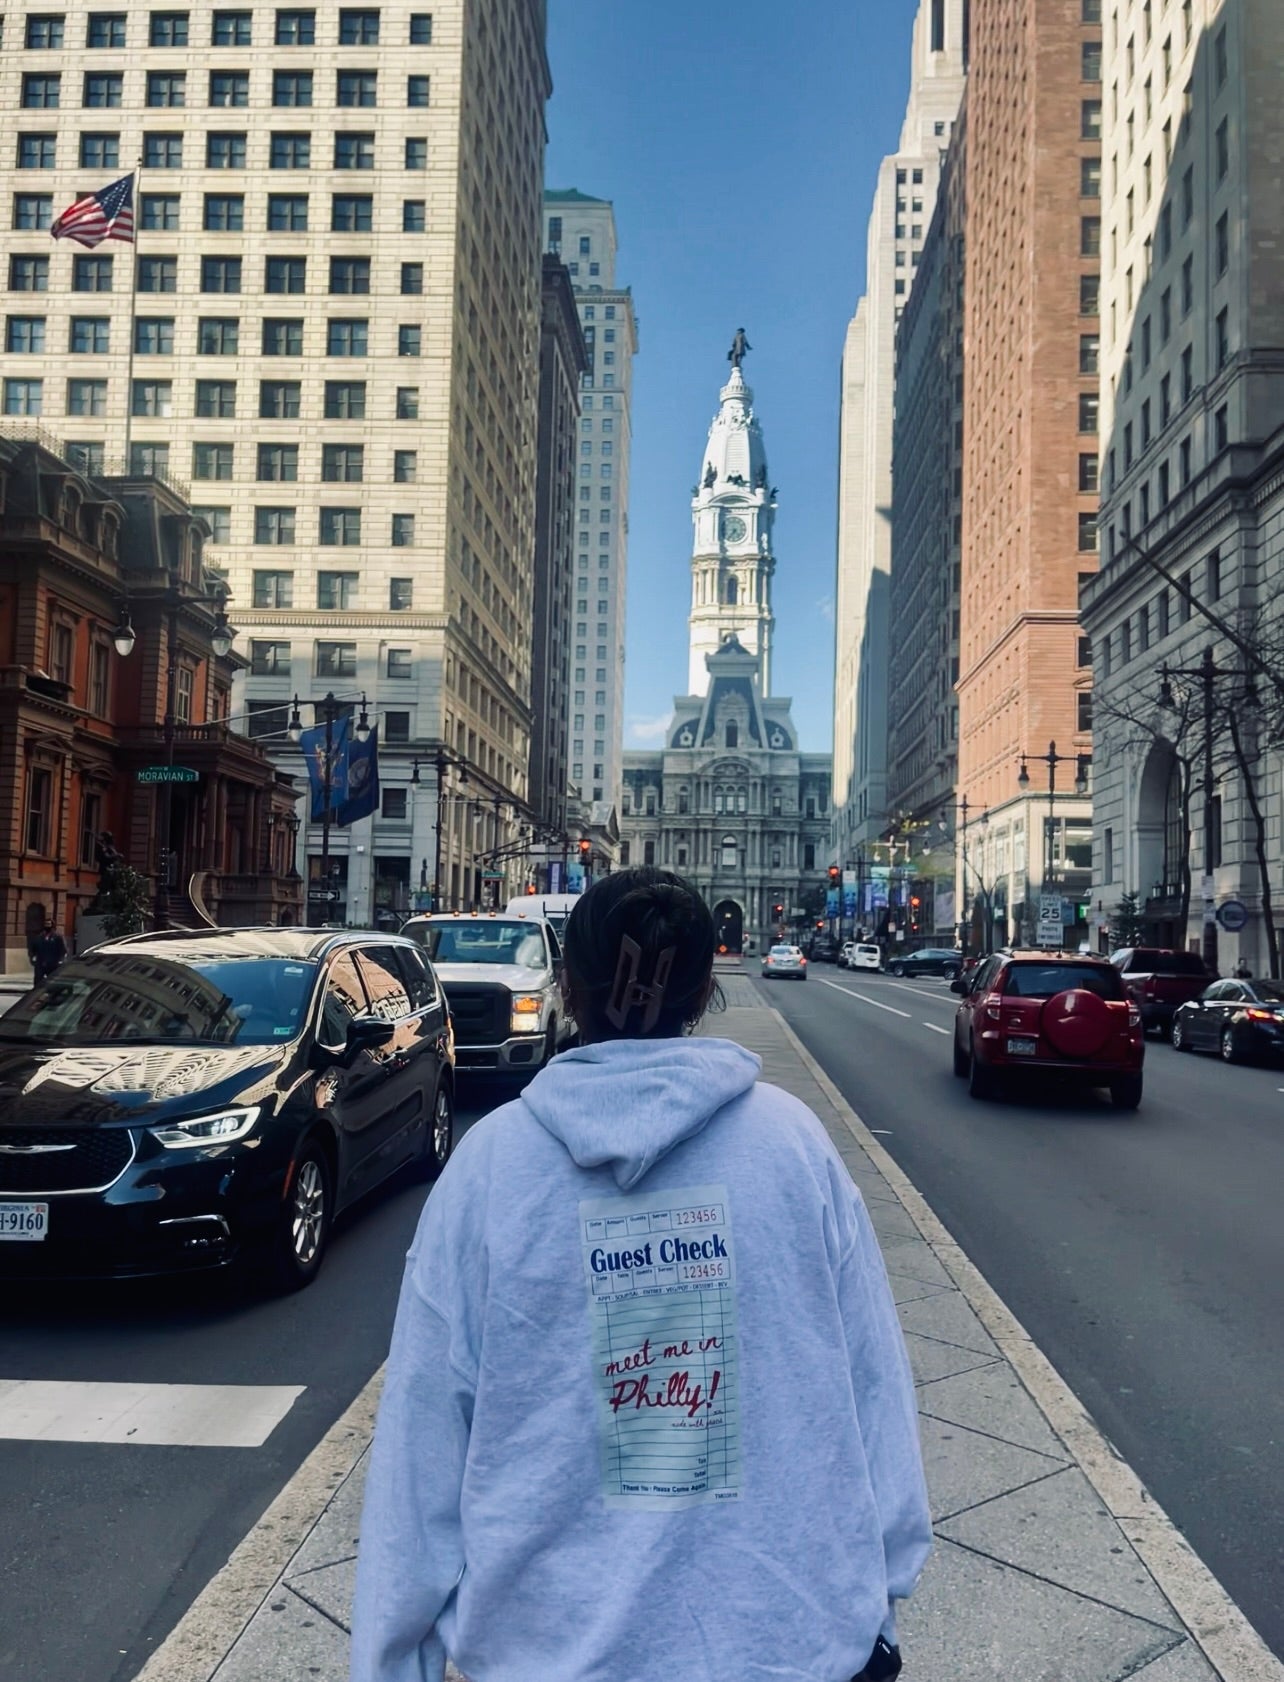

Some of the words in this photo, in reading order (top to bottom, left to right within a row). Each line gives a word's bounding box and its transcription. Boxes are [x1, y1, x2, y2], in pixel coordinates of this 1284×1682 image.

[138, 771, 184, 781] MORAVIAN
[1042, 908, 1060, 918] 25
[676, 1208, 716, 1225] 123456
[590, 1242, 653, 1273] Guest
[659, 1234, 728, 1264] Check
[684, 1263, 724, 1278] 123456
[605, 1338, 656, 1376] meet
[664, 1340, 693, 1358] me
[699, 1336, 723, 1351] in
[609, 1370, 720, 1418] Philly!
